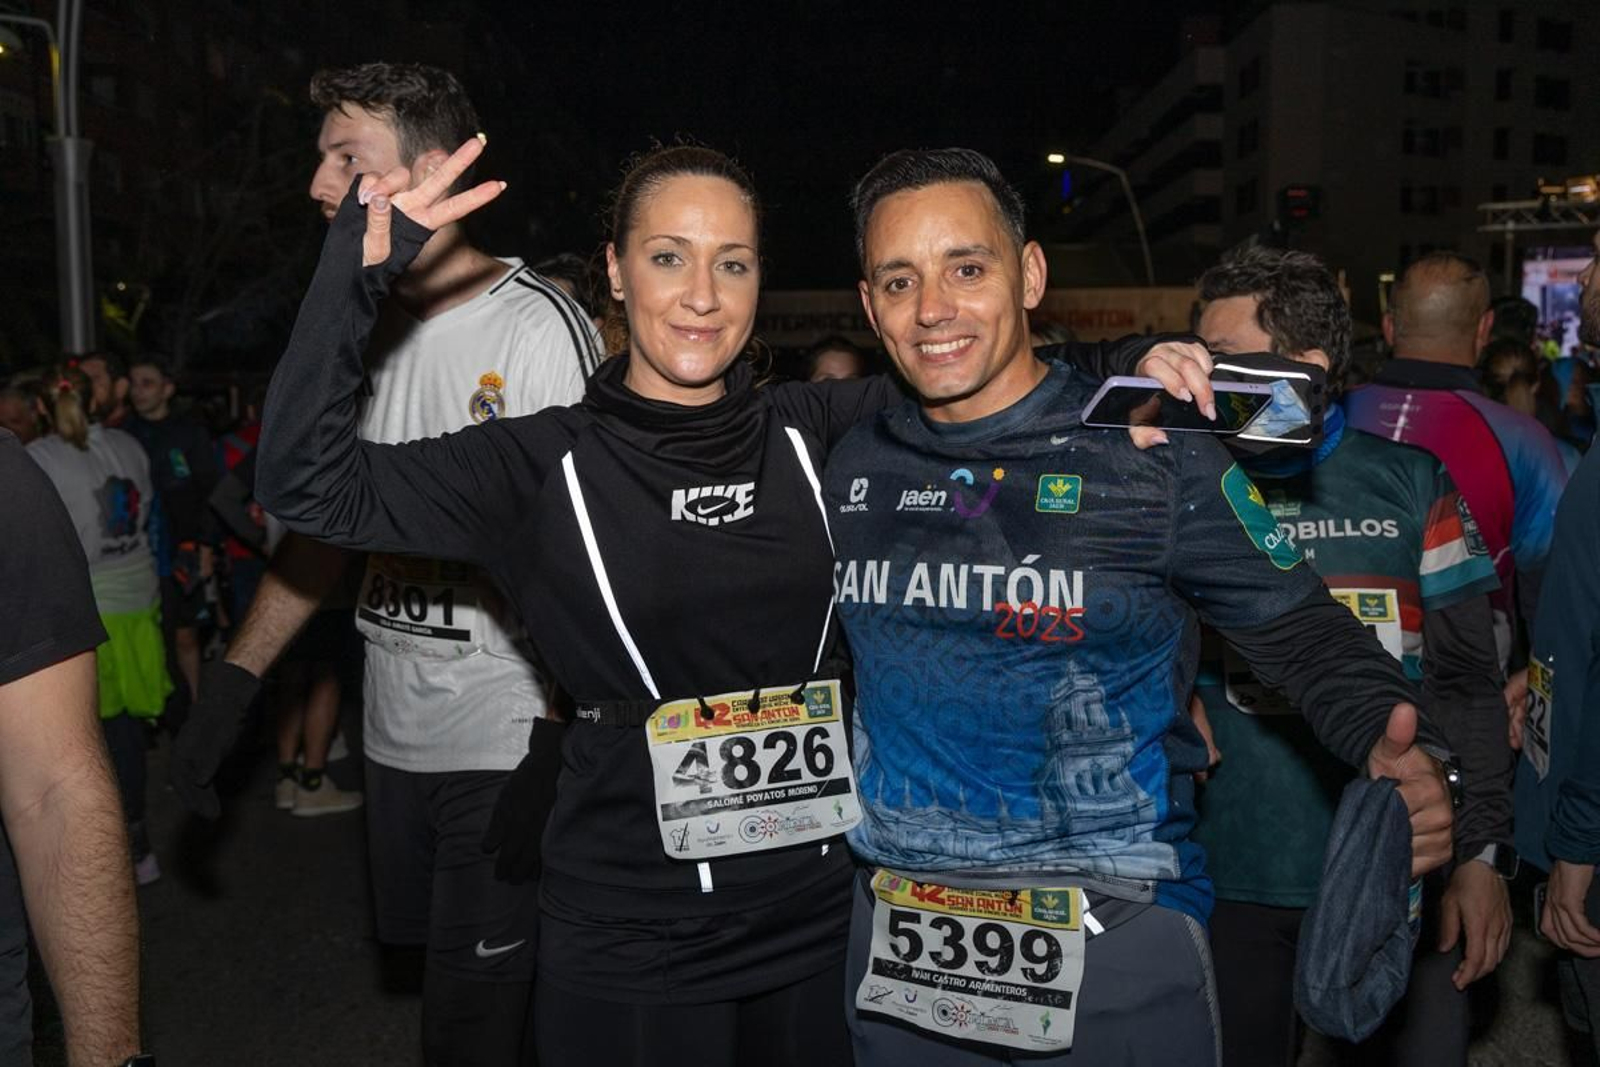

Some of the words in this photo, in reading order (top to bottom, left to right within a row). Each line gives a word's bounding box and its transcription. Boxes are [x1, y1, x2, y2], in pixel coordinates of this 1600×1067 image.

[671, 482, 755, 526] NIKE
[833, 560, 890, 604] SAN
[903, 554, 1084, 617] ANTÓN
[994, 601, 1087, 641] 2025
[672, 726, 835, 795] 4826
[707, 797, 744, 808] SALOMÉ
[747, 789, 786, 803] POYATOS
[788, 785, 818, 797] MORENO
[946, 894, 974, 907] SAN
[888, 908, 1063, 984] 5399
[932, 973, 966, 988] CASTRO
[968, 980, 1028, 997] ARMENTEROS
